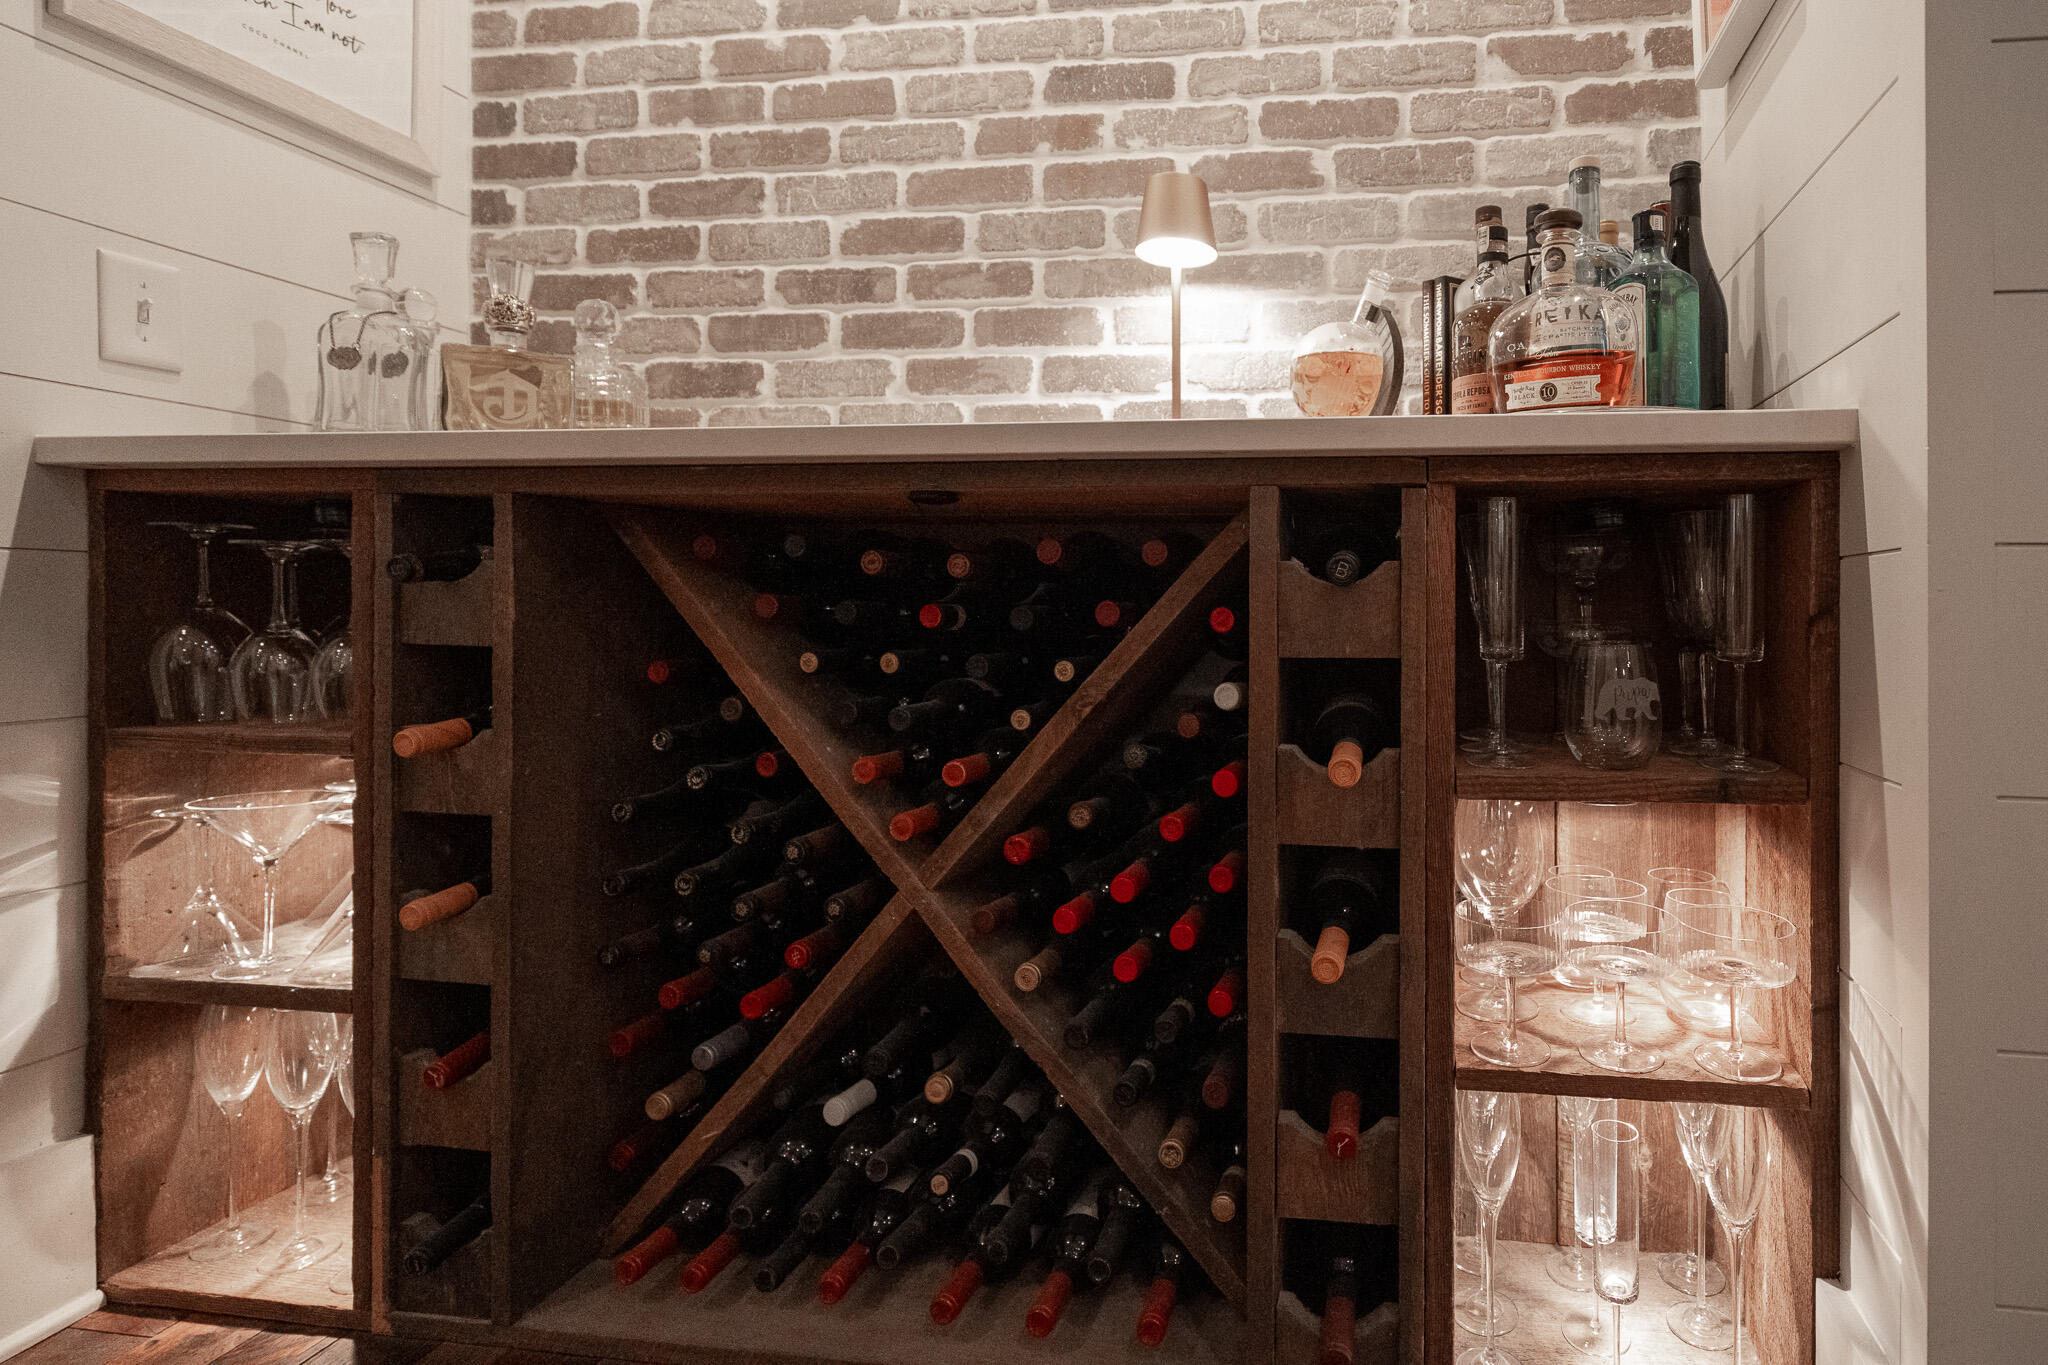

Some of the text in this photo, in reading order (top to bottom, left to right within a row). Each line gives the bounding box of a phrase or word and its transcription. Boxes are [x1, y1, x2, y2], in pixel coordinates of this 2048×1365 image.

[280, 0, 305, 31] I
[304, 19, 325, 34] am
[331, 31, 366, 54] not
[1435, 337, 1443, 406] BARTENDER'S
[1569, 363, 1601, 372] WHISKEY
[1466, 385, 1491, 397] REPOSA
[1541, 386, 1555, 397] 10
[1423, 397, 1430, 410] TO
[1335, 560, 1349, 578] B
